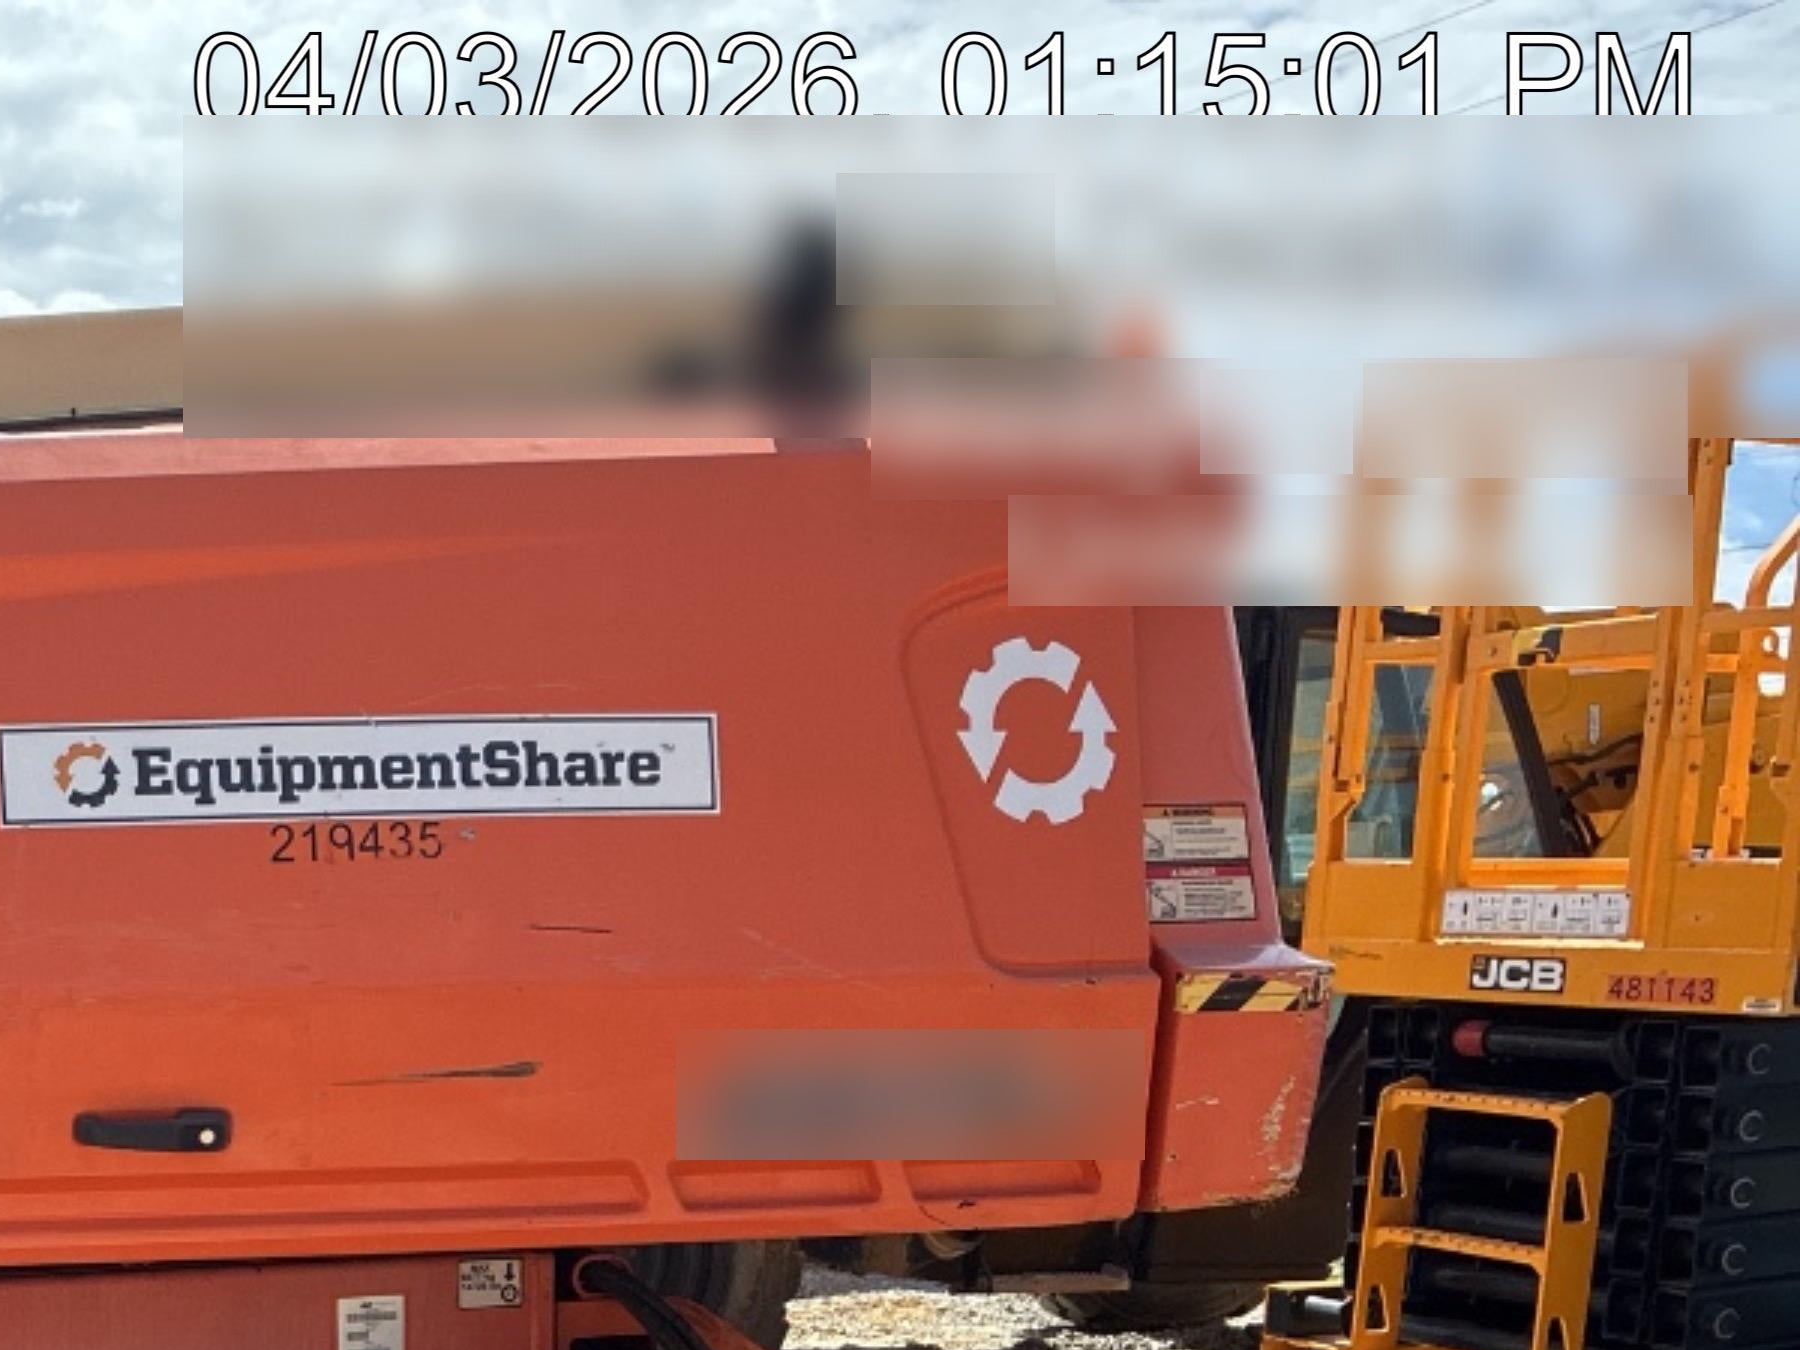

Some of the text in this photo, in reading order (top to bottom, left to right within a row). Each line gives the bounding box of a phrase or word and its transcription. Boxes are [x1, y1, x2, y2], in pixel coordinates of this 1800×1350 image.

[131, 740, 662, 805] EquipmentShare
[270, 820, 444, 864] 219435
[1471, 957, 1566, 993] JCB
[1607, 976, 1716, 1003] 481143
